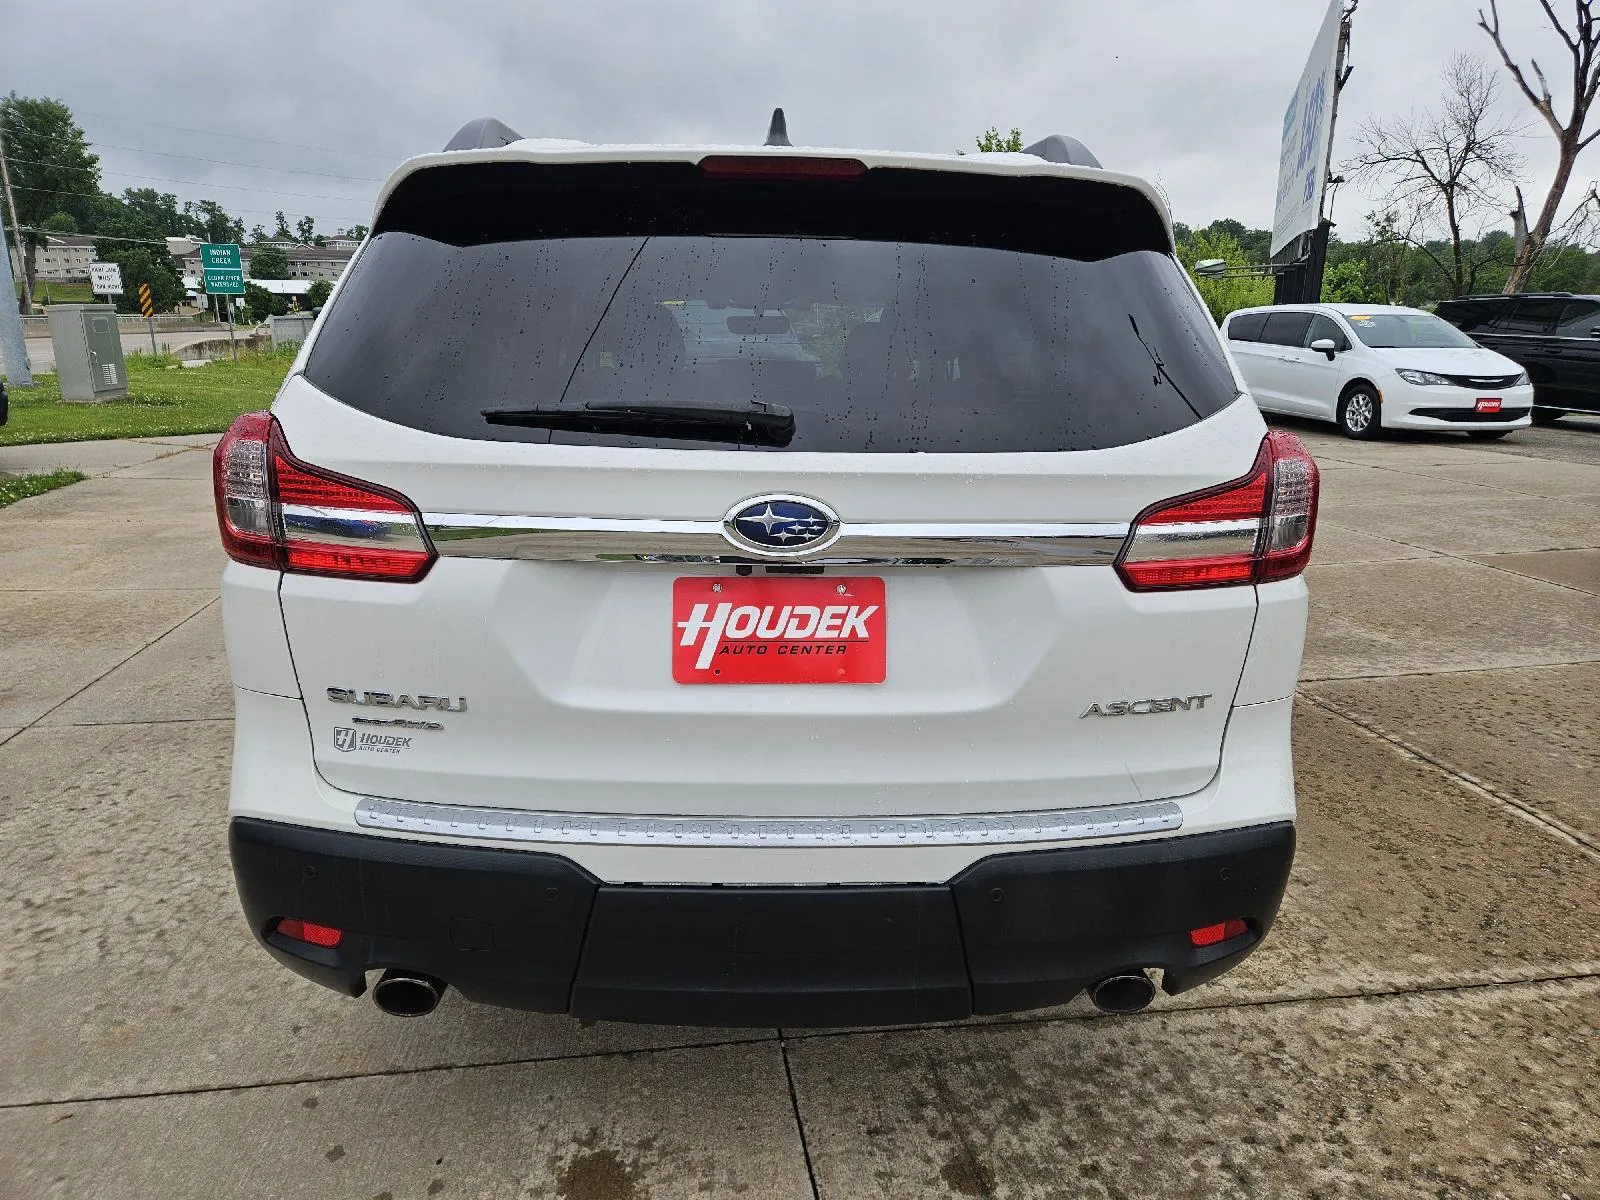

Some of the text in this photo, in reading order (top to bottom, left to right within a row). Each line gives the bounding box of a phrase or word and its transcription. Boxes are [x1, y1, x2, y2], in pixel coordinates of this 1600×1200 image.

[677, 603, 879, 669] HOUDEK
[719, 645, 848, 655] AUTO CENTER
[327, 686, 467, 712] SUBARU
[1080, 693, 1212, 718] ASCENT
[359, 732, 412, 748] HOUDEK
